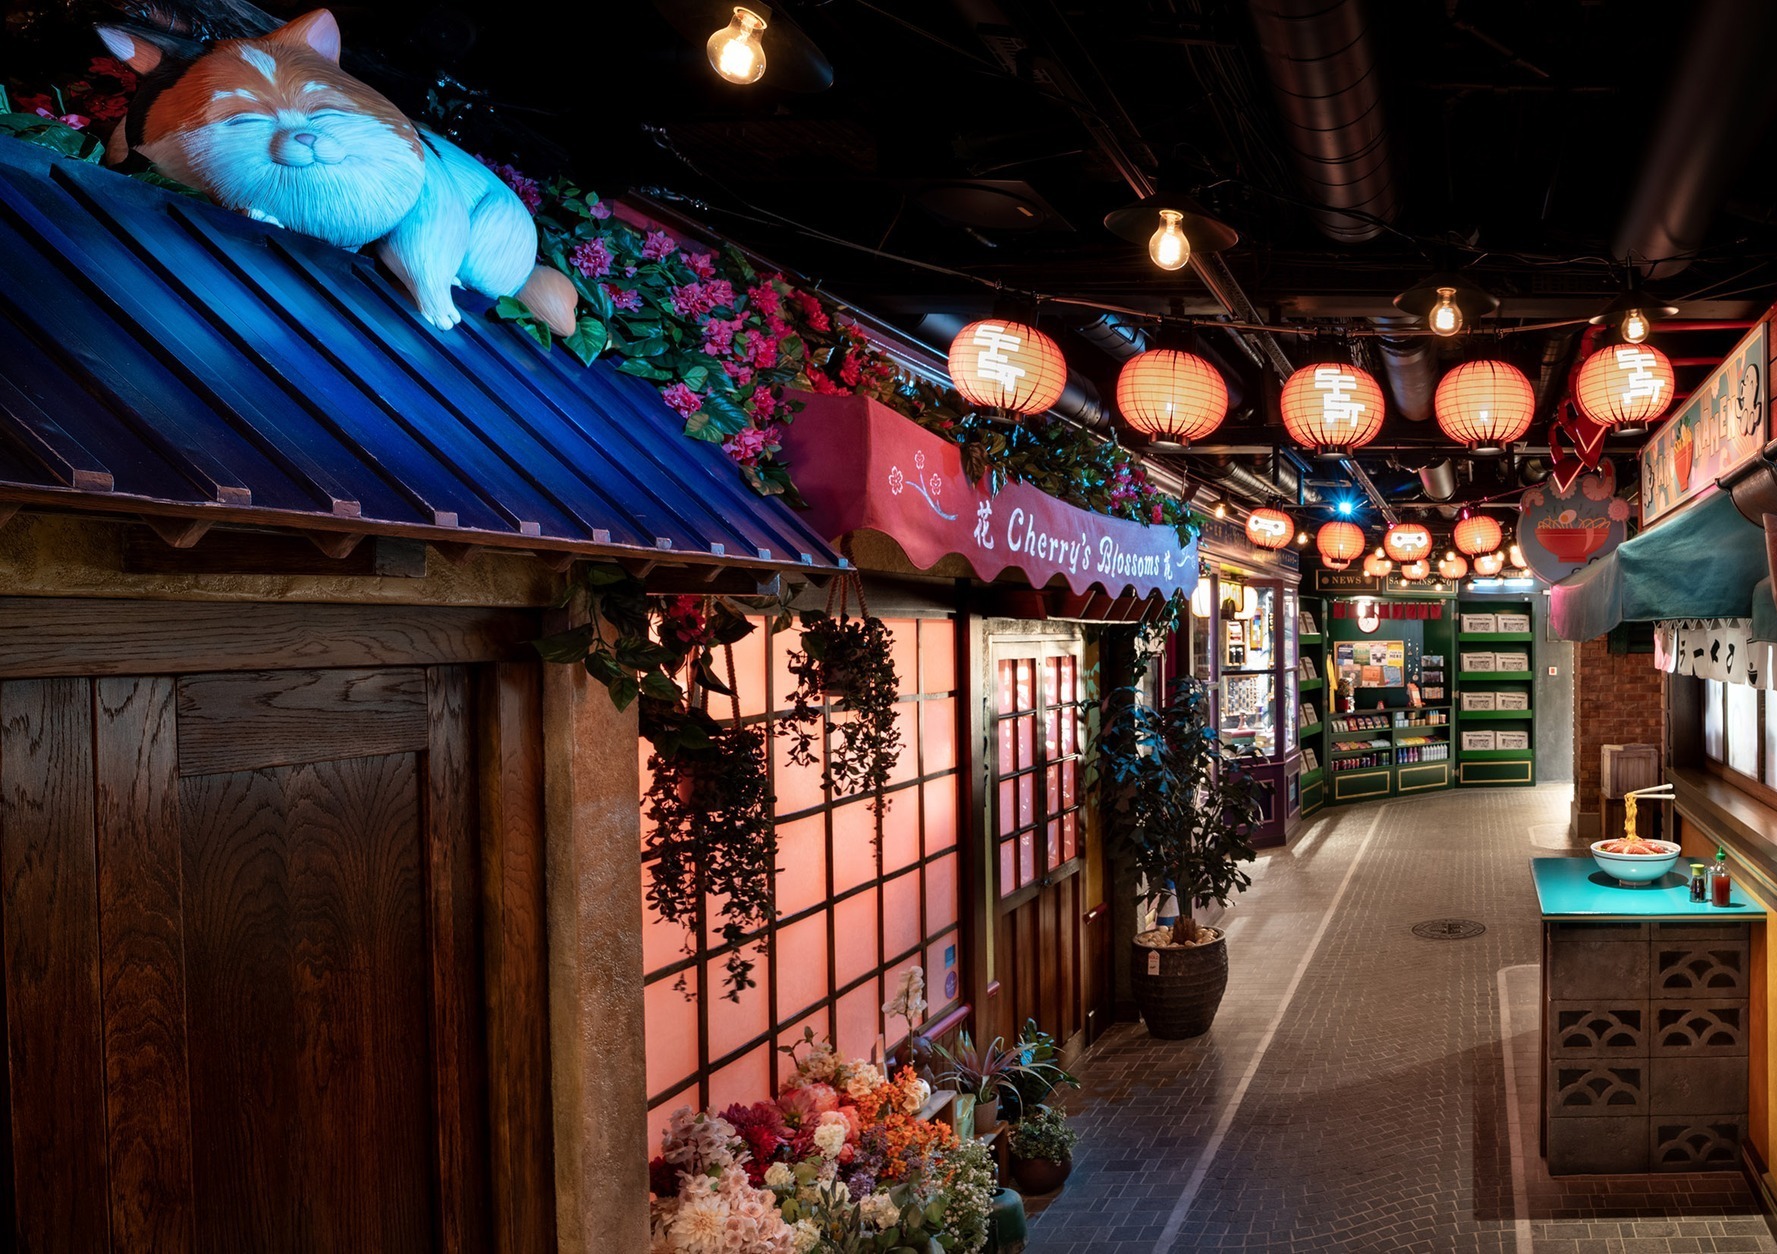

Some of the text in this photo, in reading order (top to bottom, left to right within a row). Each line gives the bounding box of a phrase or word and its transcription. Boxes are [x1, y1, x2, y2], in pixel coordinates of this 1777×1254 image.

[1694, 395, 1736, 460] RAMEN
[974, 500, 995, 550] 花
[1007, 507, 1091, 574] Cherry's
[1097, 535, 1160, 578] Blossoms
[1331, 576, 1362, 585] NEWS
